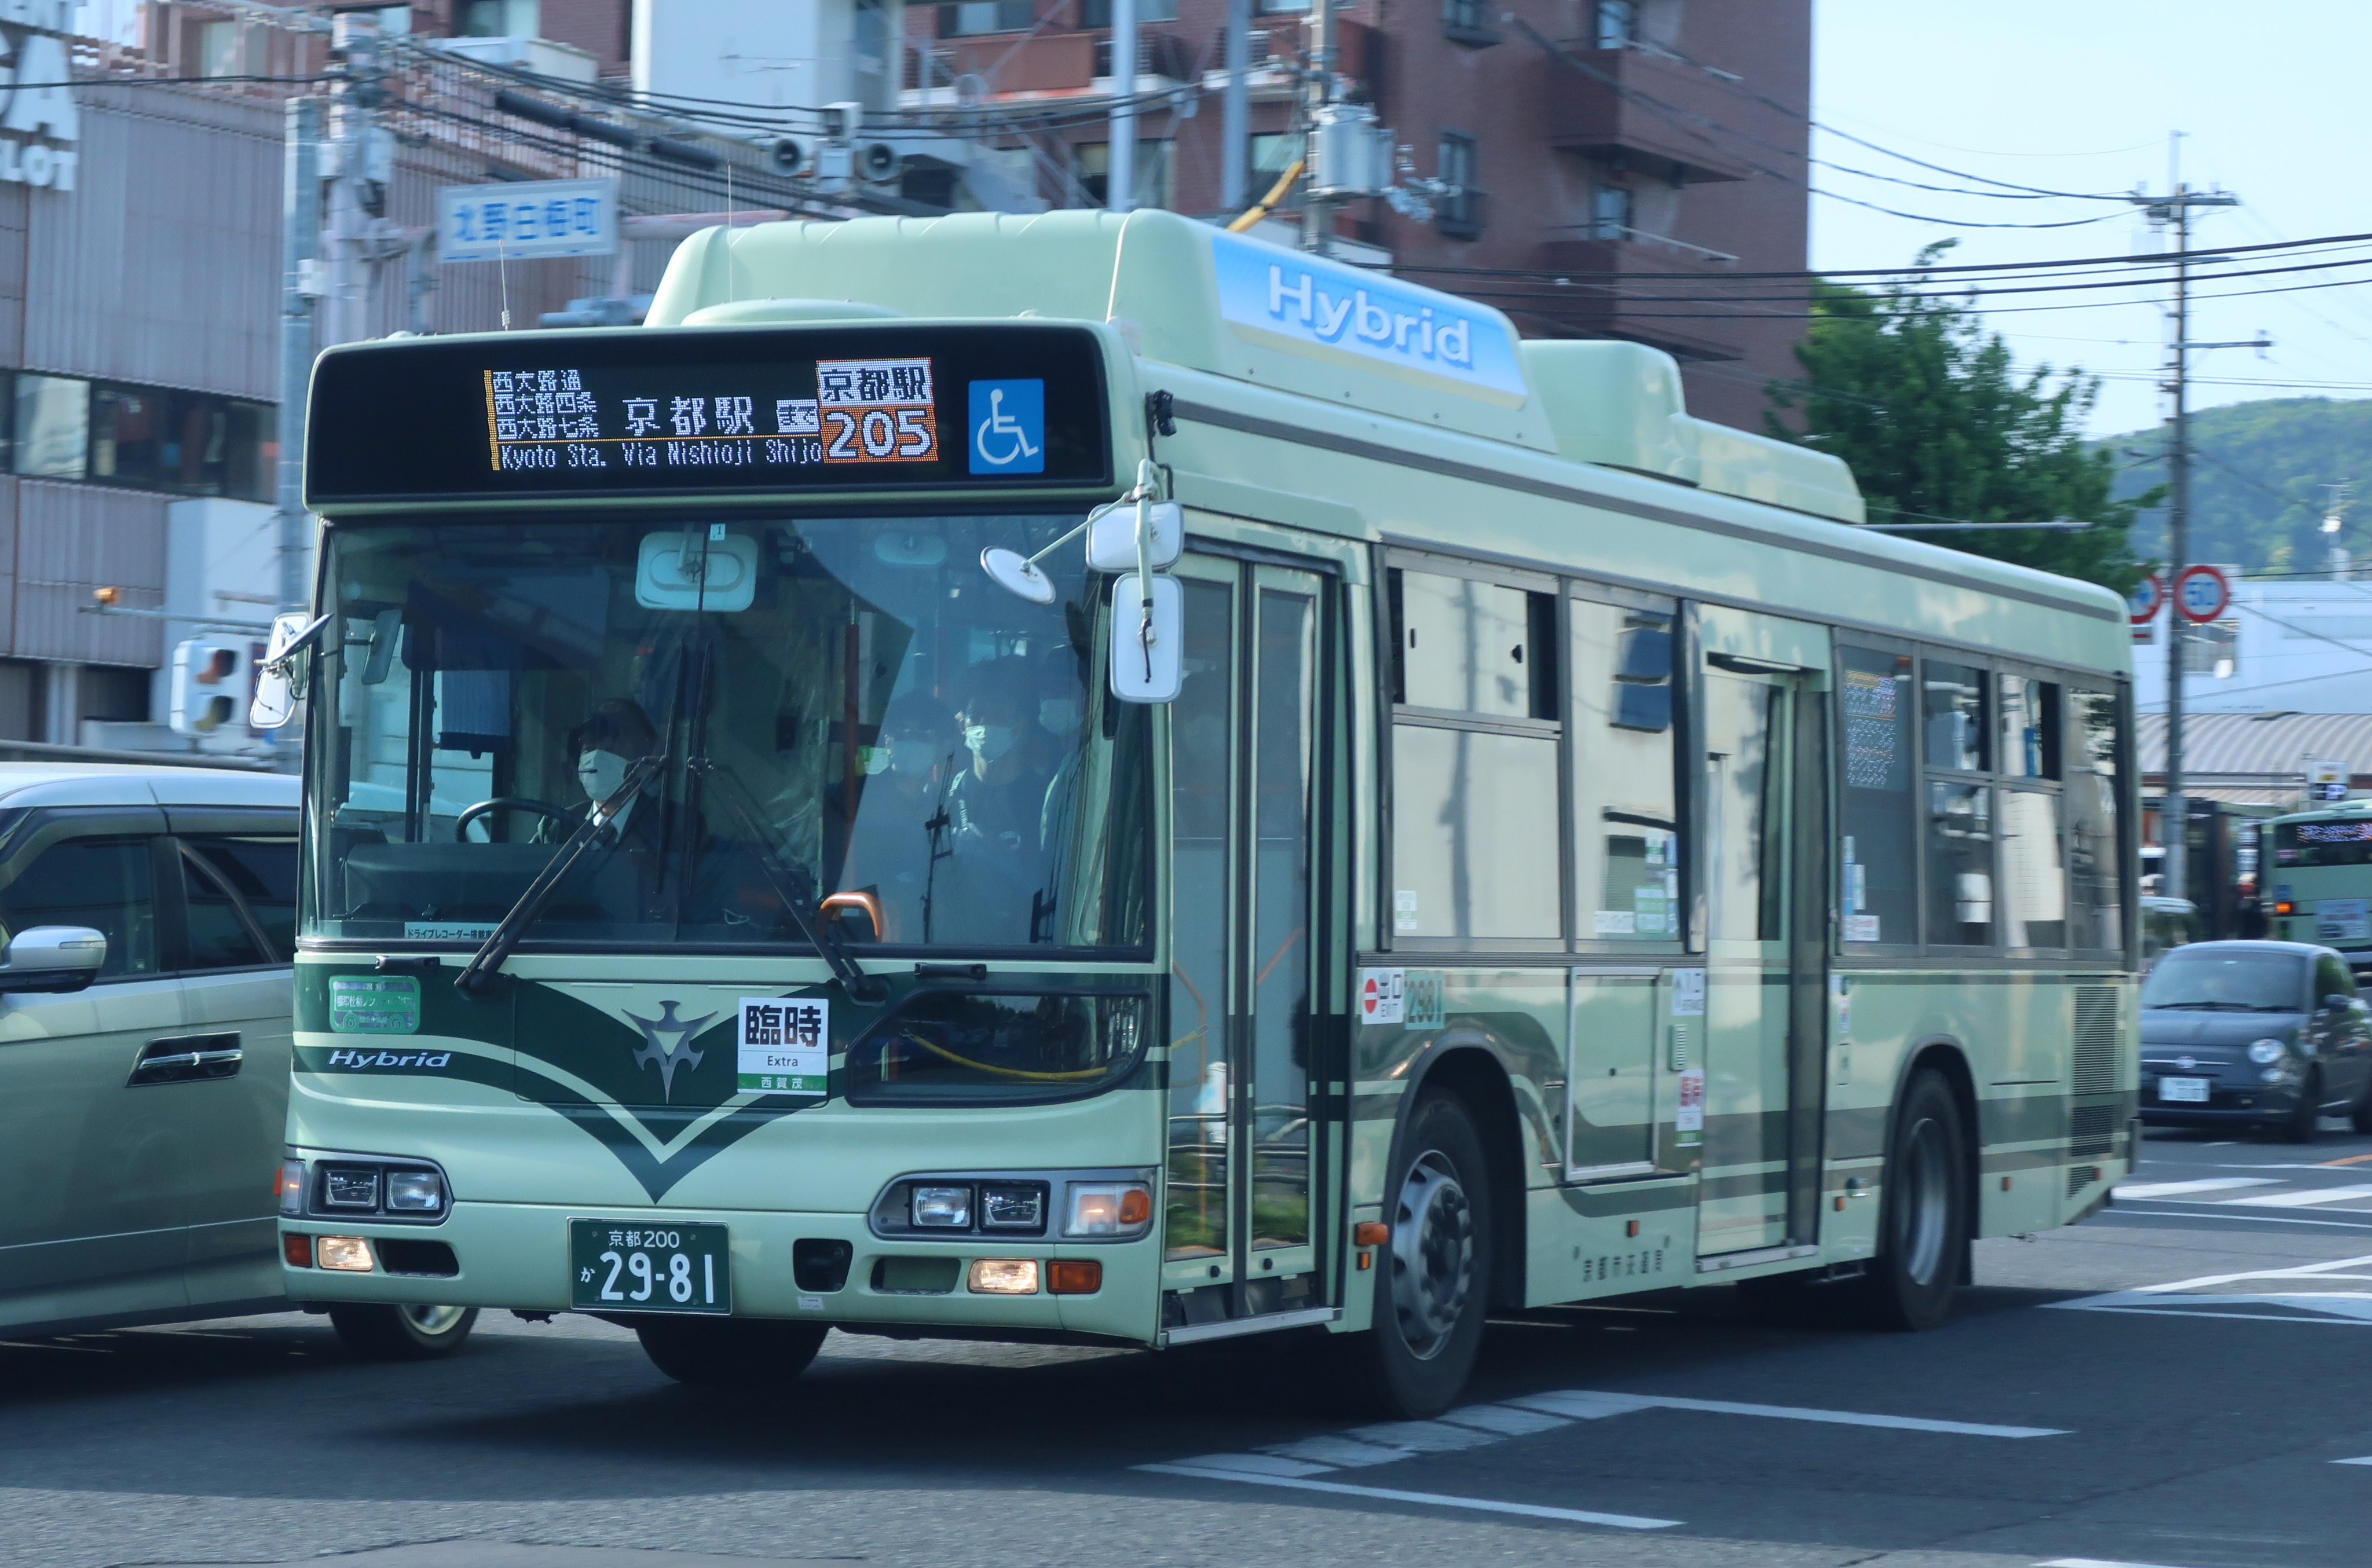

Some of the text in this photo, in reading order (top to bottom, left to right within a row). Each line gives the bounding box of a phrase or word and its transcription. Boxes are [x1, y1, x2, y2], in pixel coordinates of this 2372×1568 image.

[1269, 264, 1471, 365] Hybrid
[493, 369, 581, 392] 西大路通
[820, 367, 926, 402] 京都駅
[495, 391, 597, 415] 西大路四条
[622, 395, 754, 437] 京都駅
[496, 415, 599, 439] 西大路七条
[825, 409, 932, 459] 205
[501, 438, 822, 470] Kyoto Sta. Via Nishioji Shijo
[408, 929, 502, 939] ドライブレコーダー搭載車
[745, 1005, 822, 1047] 臨時
[328, 1049, 452, 1069] Hybrid
[767, 1056, 799, 1067] Extra
[761, 1076, 803, 1089] 西賀茂
[580, 1251, 714, 1304] か 29-81
